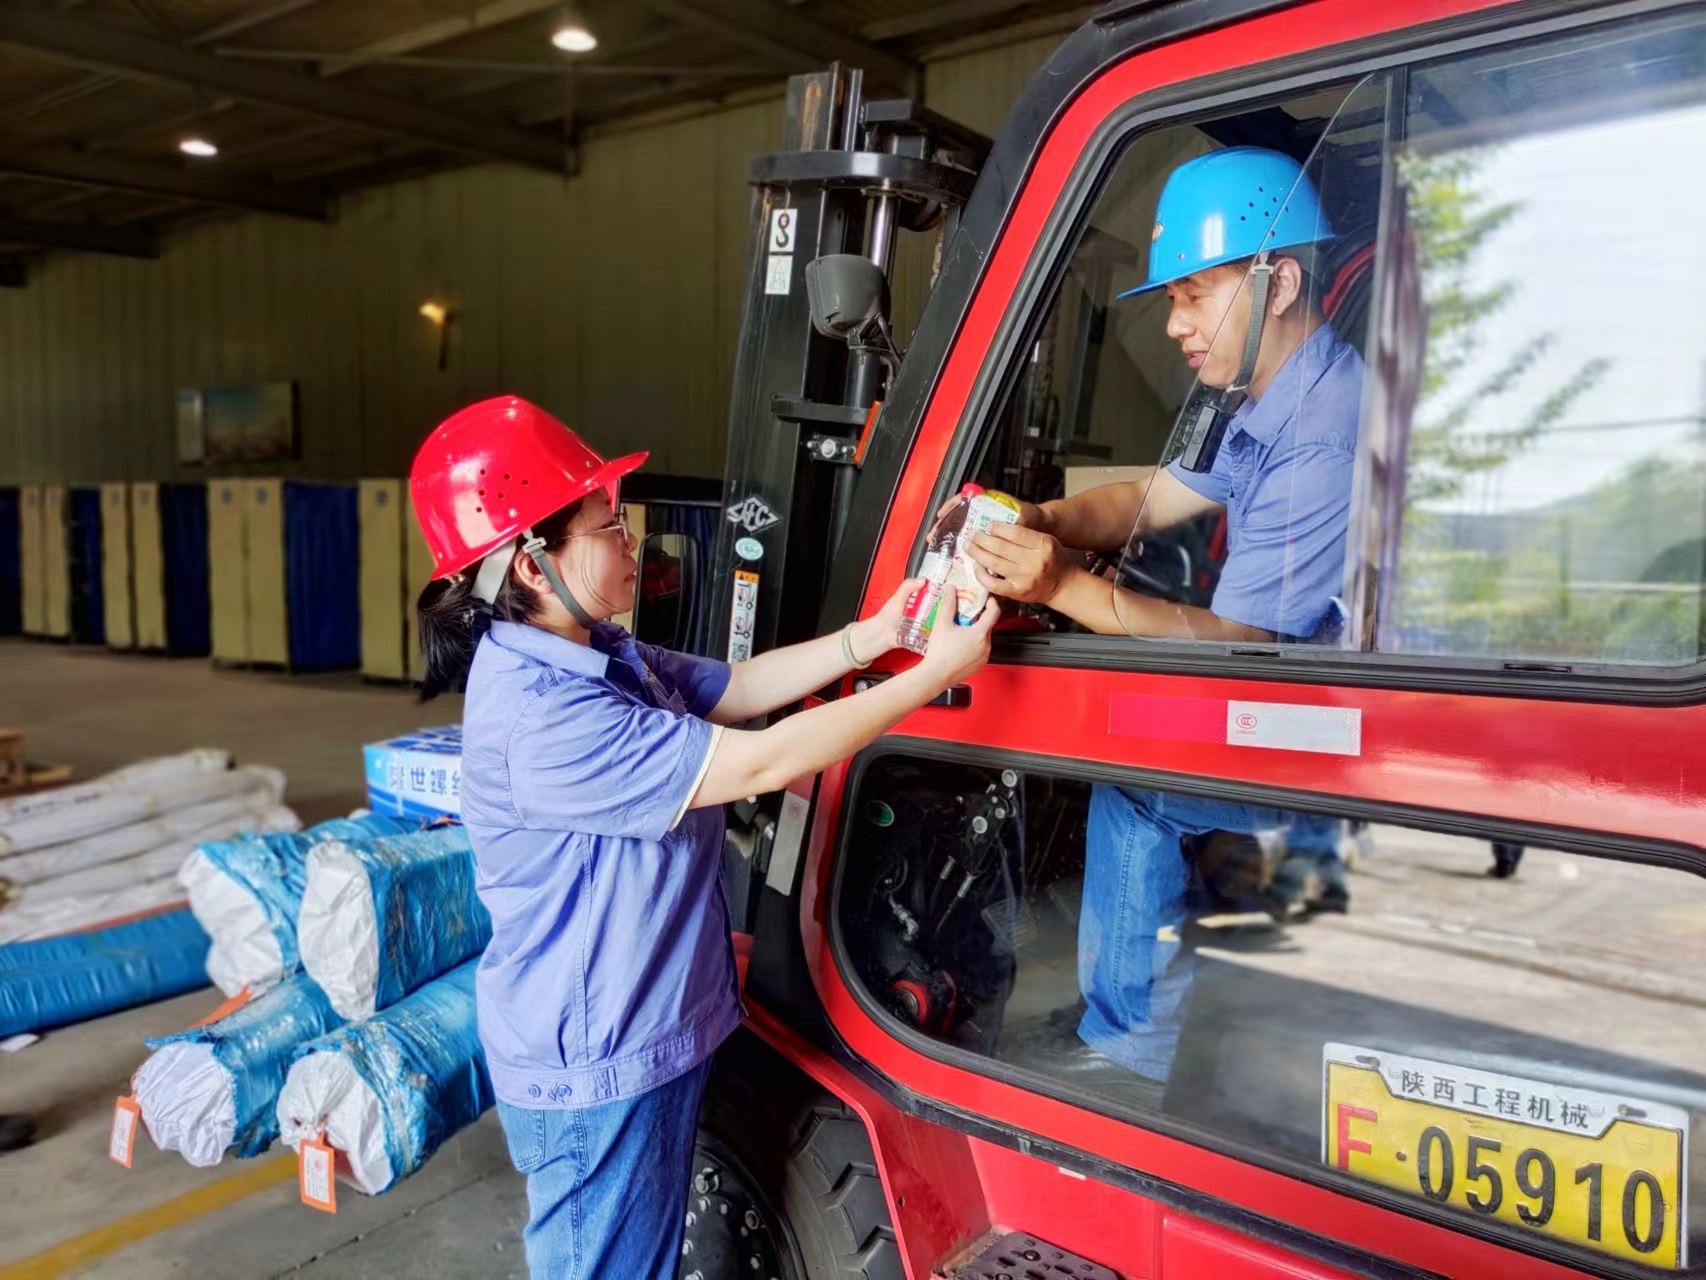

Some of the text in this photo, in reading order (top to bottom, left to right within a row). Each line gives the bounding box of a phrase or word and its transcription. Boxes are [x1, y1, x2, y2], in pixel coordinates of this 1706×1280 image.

[1401, 1068, 1590, 1131] 陕西工程机械
